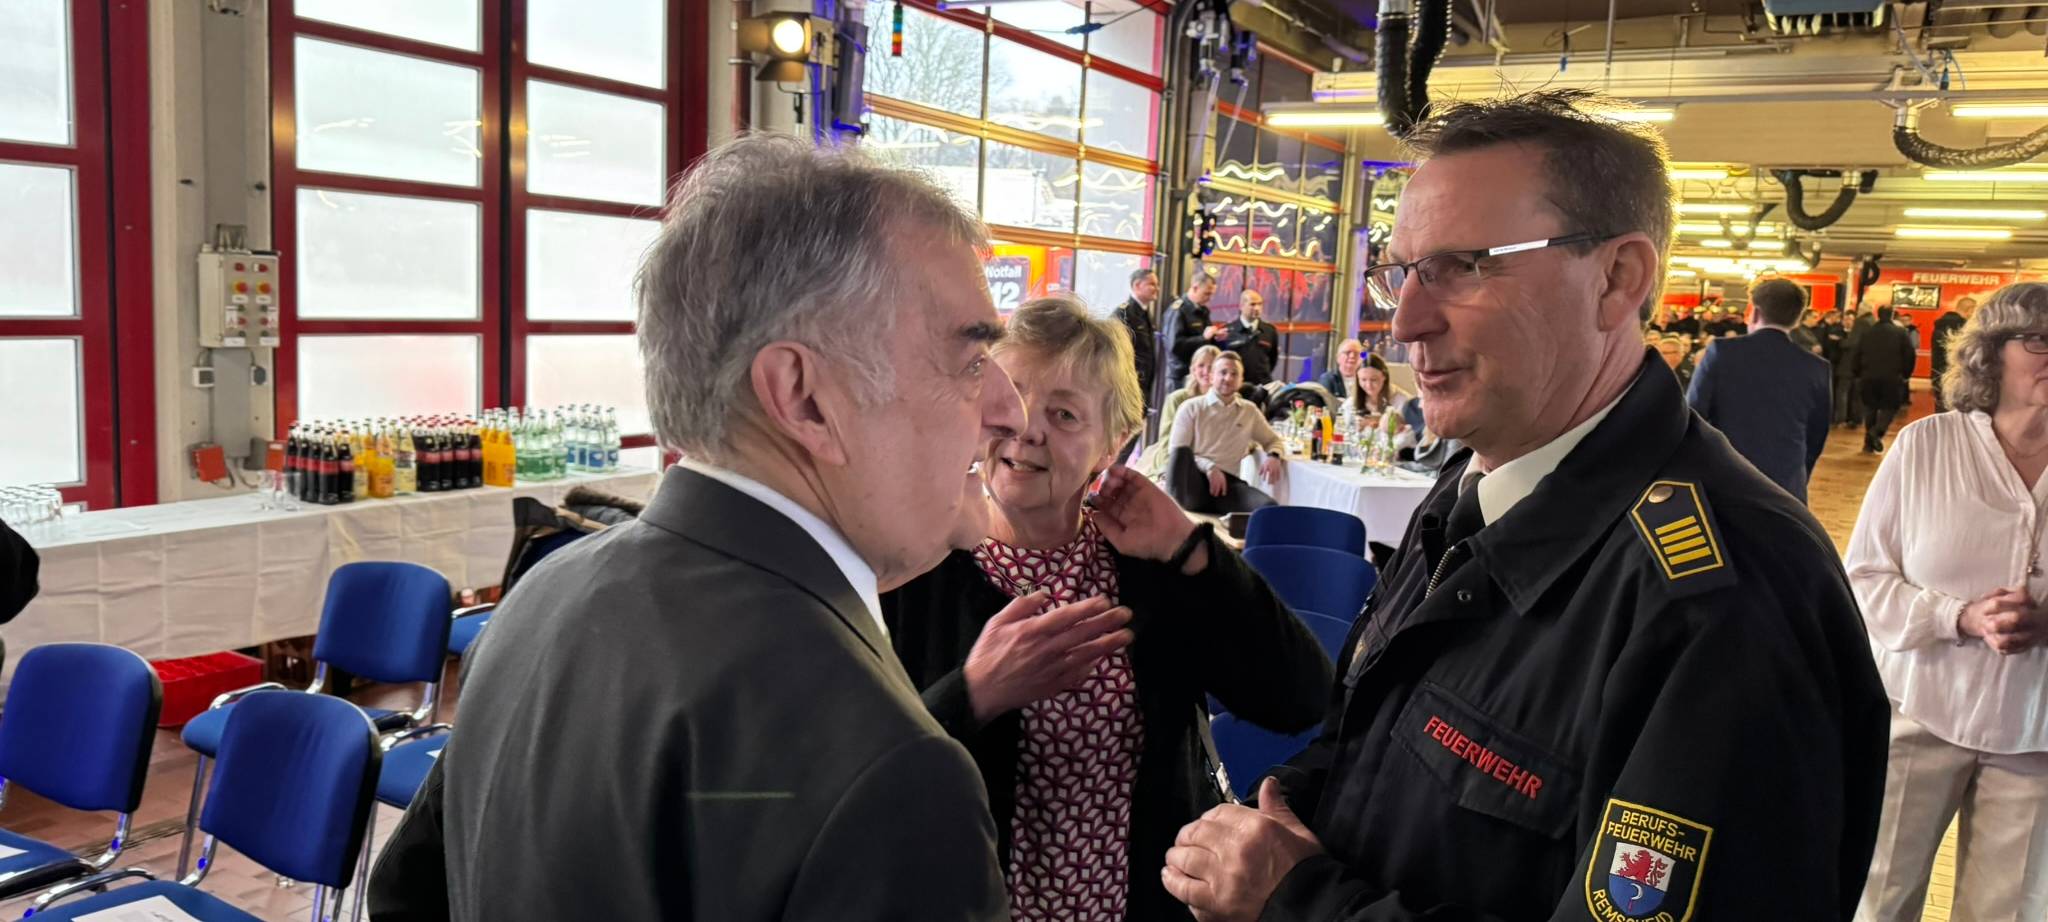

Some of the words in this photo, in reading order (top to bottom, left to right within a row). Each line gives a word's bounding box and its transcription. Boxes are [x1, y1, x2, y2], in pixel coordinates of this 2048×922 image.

[1911, 272, 2000, 286] FEUERWEHR
[1423, 715, 1543, 799] FEUERWEHR
[1621, 810, 1685, 837] BERUFS-
[1606, 821, 1697, 862] FEUERWEHR
[1592, 889, 1674, 922] REMSID
